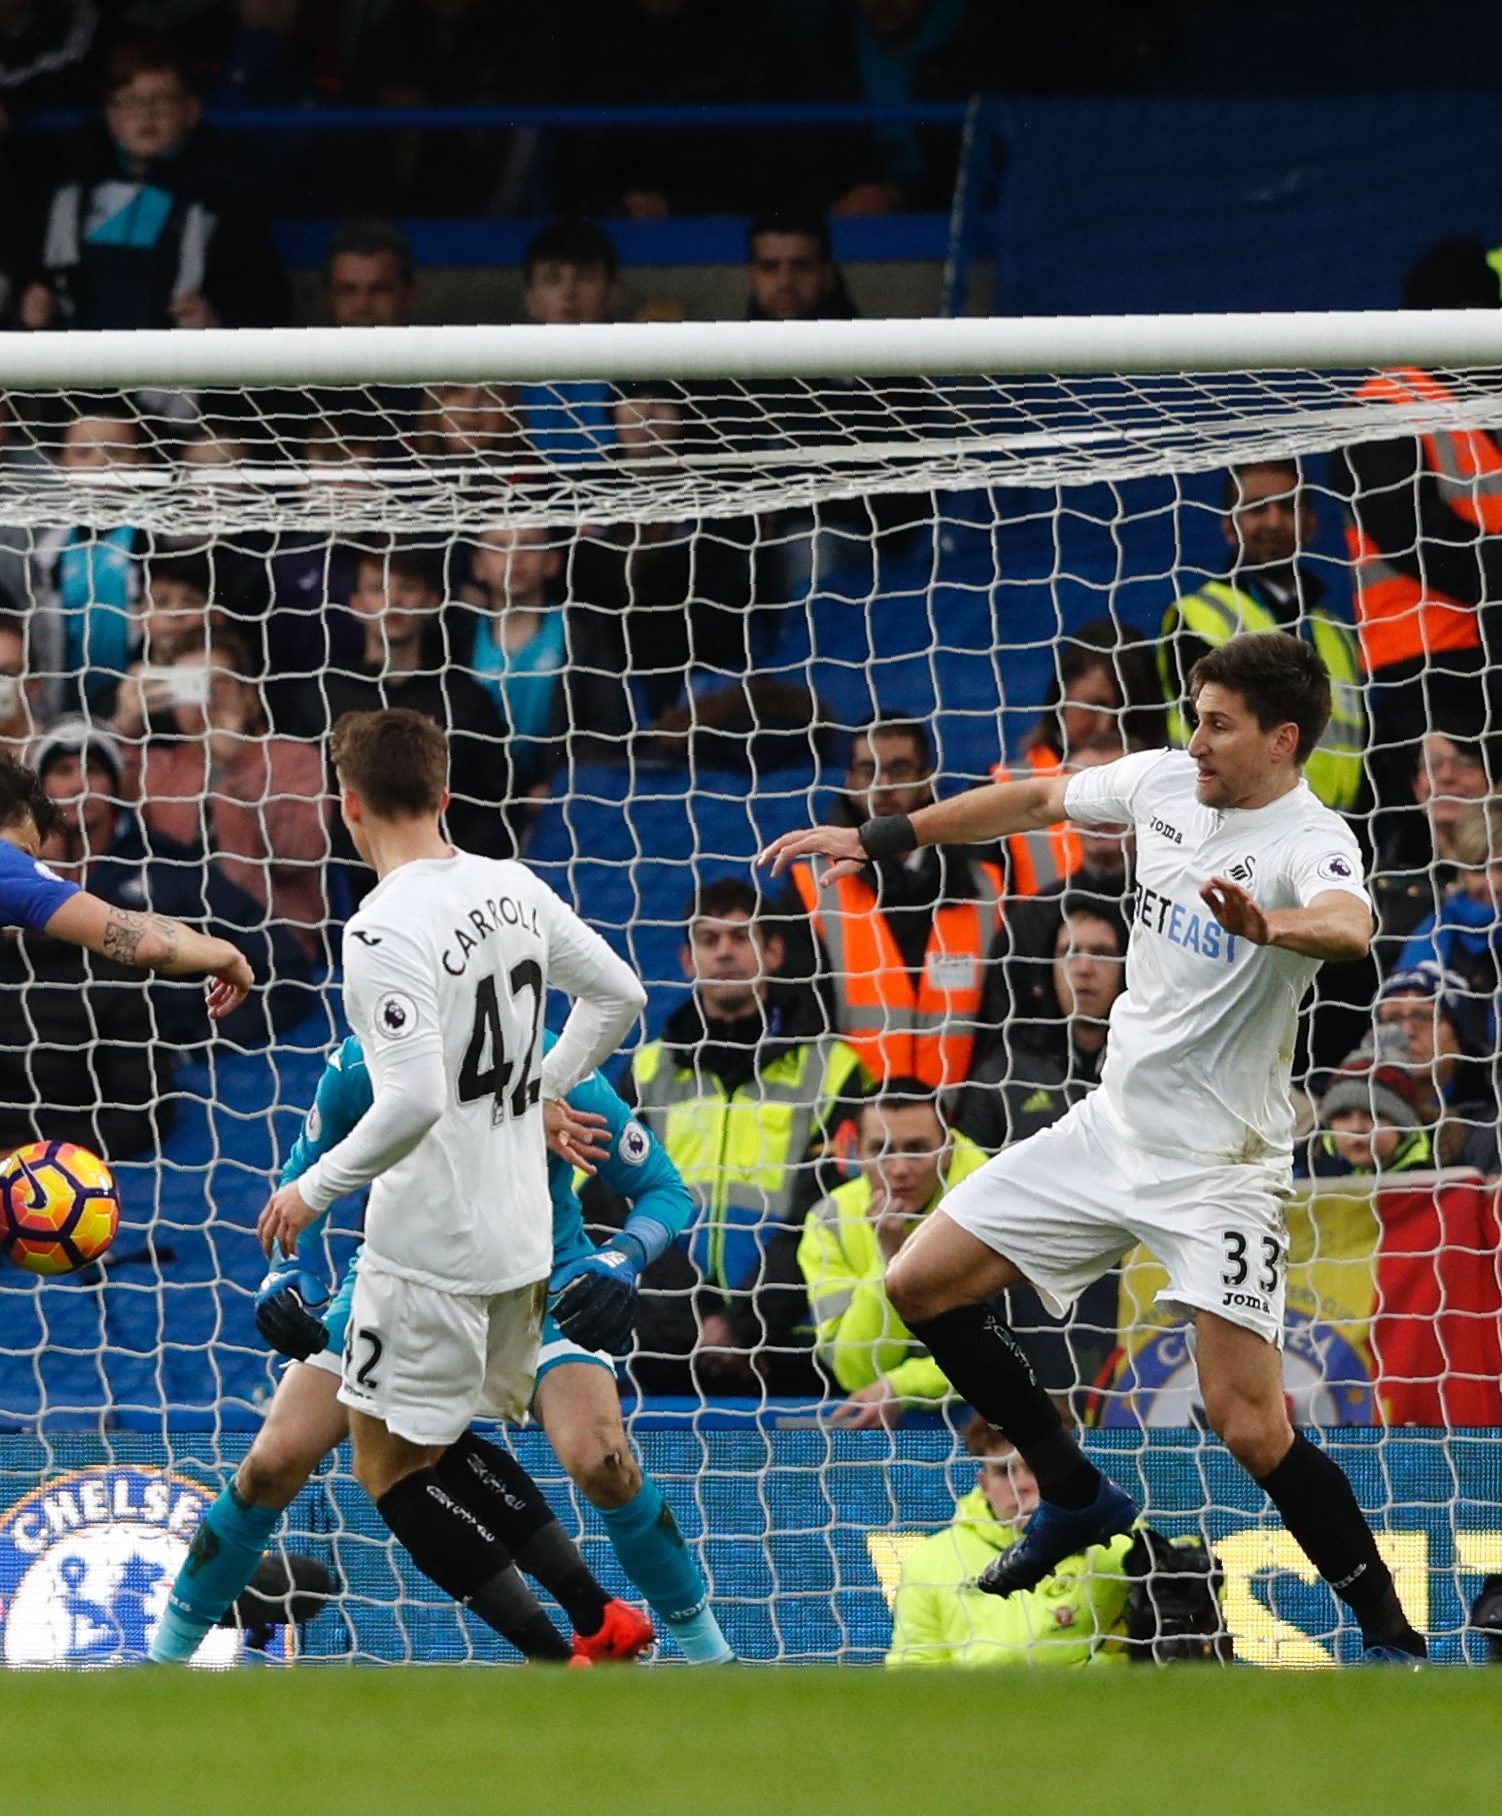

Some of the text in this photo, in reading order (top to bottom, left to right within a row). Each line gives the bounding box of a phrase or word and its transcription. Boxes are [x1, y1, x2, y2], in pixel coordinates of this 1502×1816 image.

[442, 896, 541, 976] CARROLL
[455, 956, 544, 1126] 42
[1222, 1230, 1282, 1294] 33
[13, 1478, 204, 1554] CHELSE
